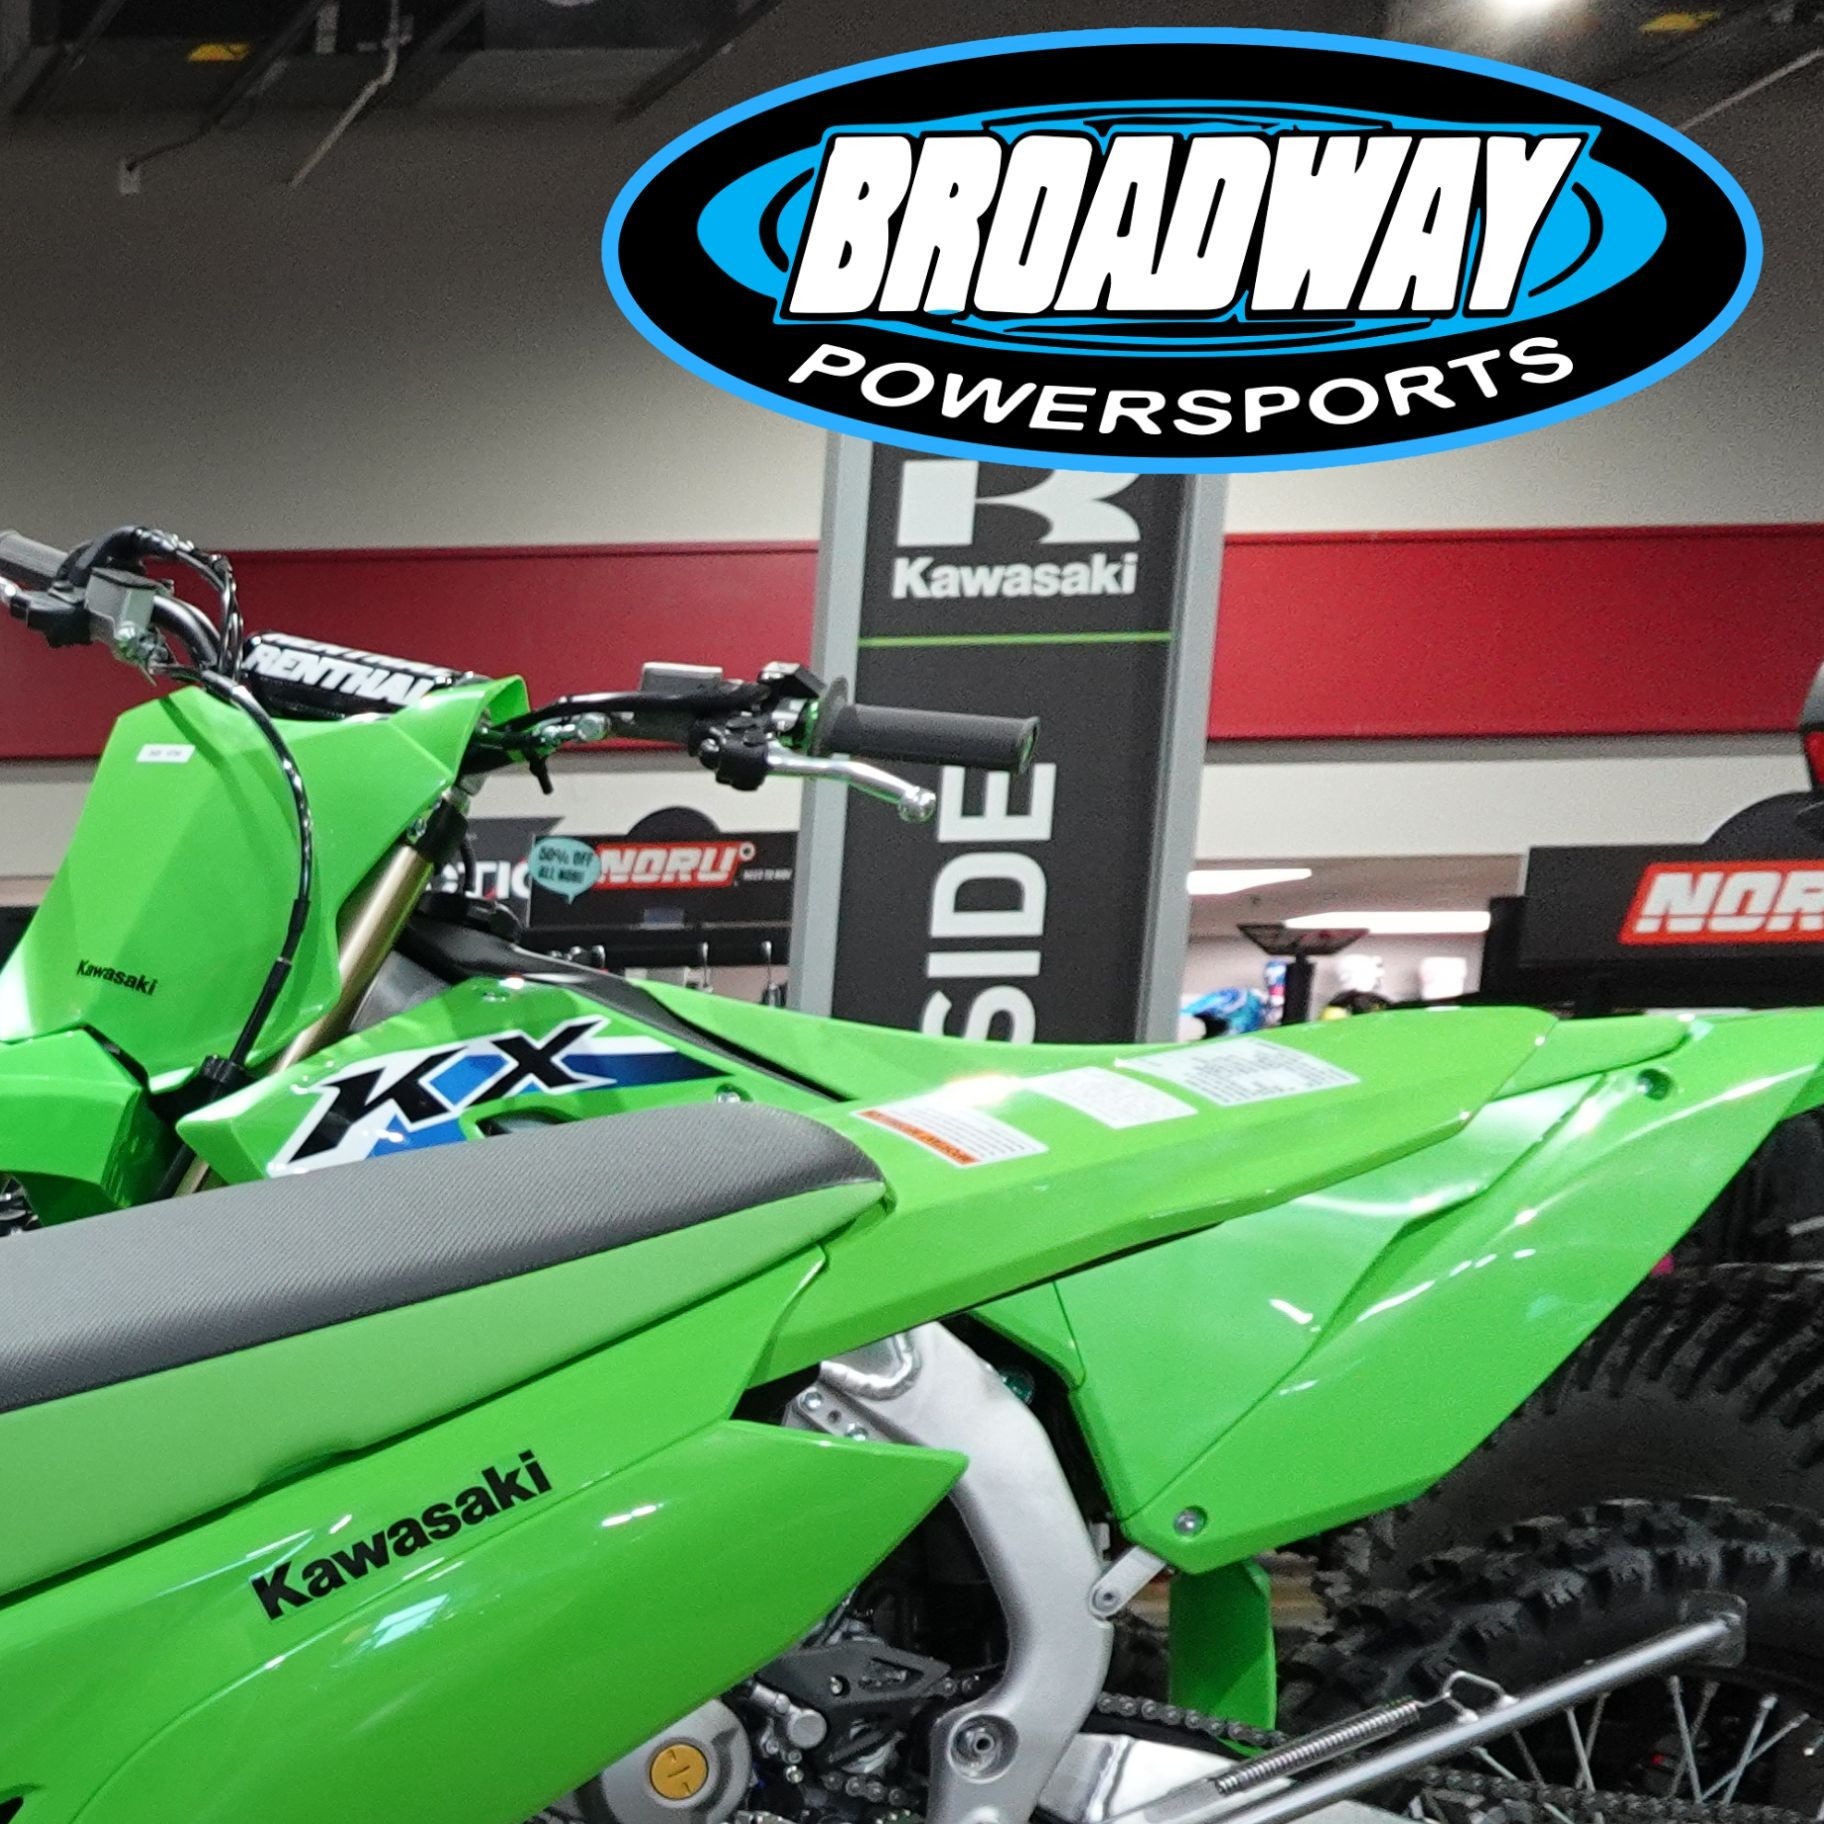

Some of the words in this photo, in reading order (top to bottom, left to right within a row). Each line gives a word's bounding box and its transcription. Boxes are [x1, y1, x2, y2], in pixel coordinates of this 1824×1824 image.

[892, 552, 1140, 599] Kawasaki
[597, 846, 739, 885] NORU
[76, 958, 159, 996] Kawasaki
[285, 1017, 606, 1166] KX
[251, 1449, 553, 1621] Kawasaki
